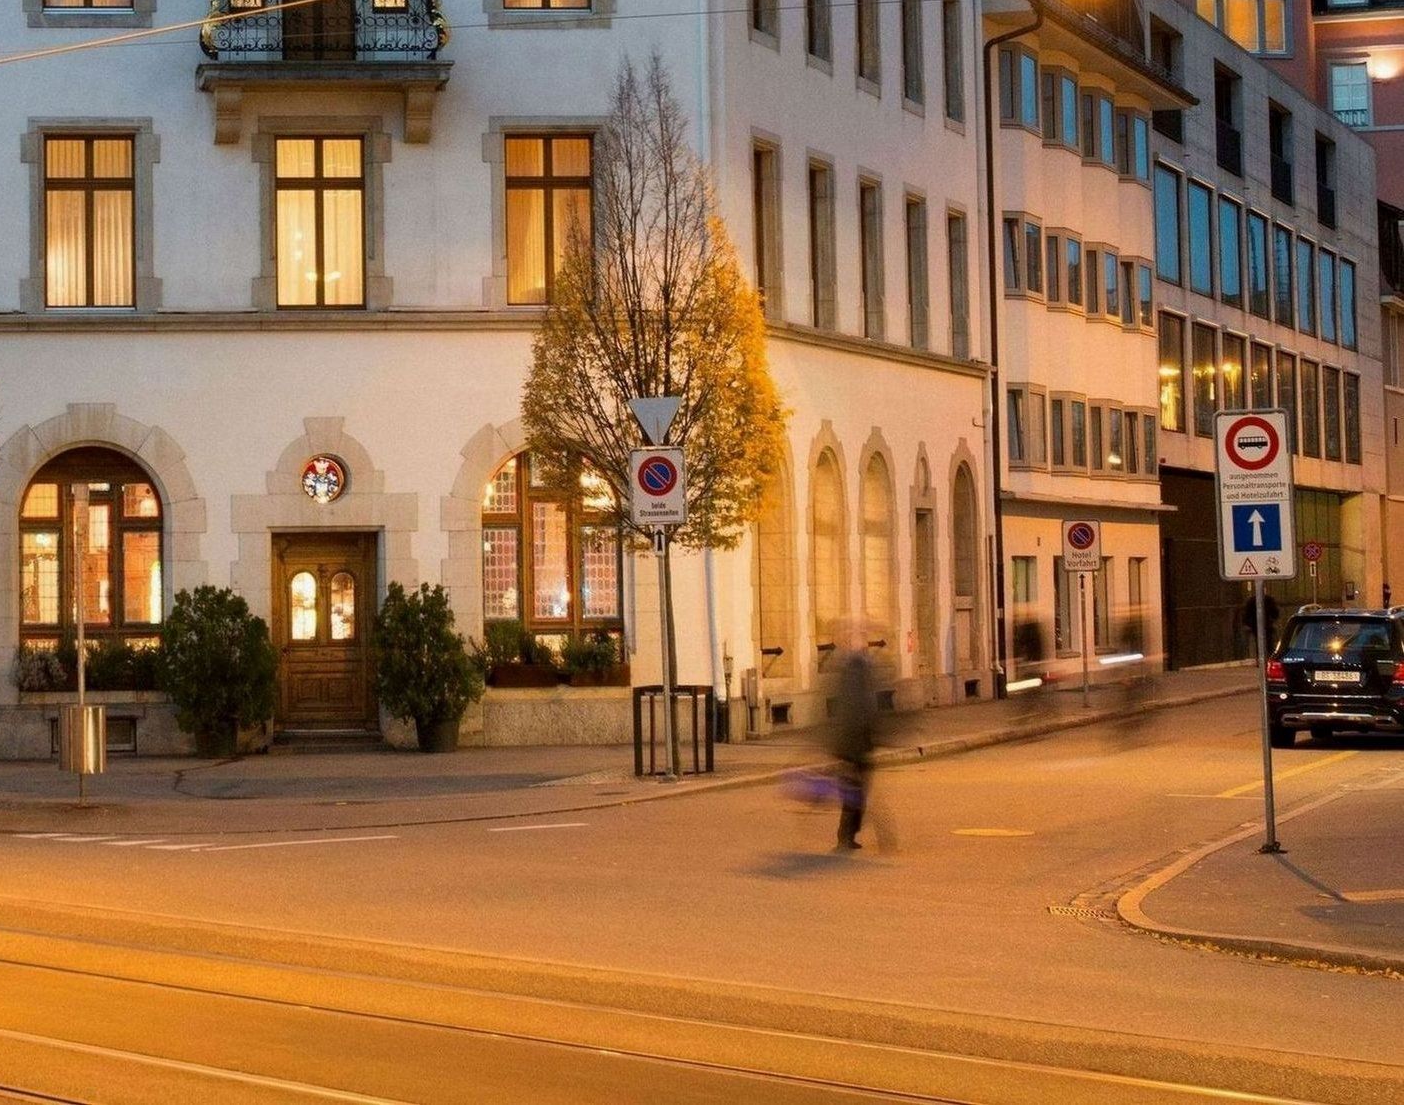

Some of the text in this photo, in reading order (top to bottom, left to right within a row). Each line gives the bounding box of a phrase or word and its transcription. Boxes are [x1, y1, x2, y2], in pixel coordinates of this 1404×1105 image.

[1228, 472, 1279, 480] ausgenommen
[1223, 481, 1287, 490] Personaltransporte
[1241, 490, 1284, 499] Hotelzufahrt
[1071, 550, 1092, 559] Hotel
